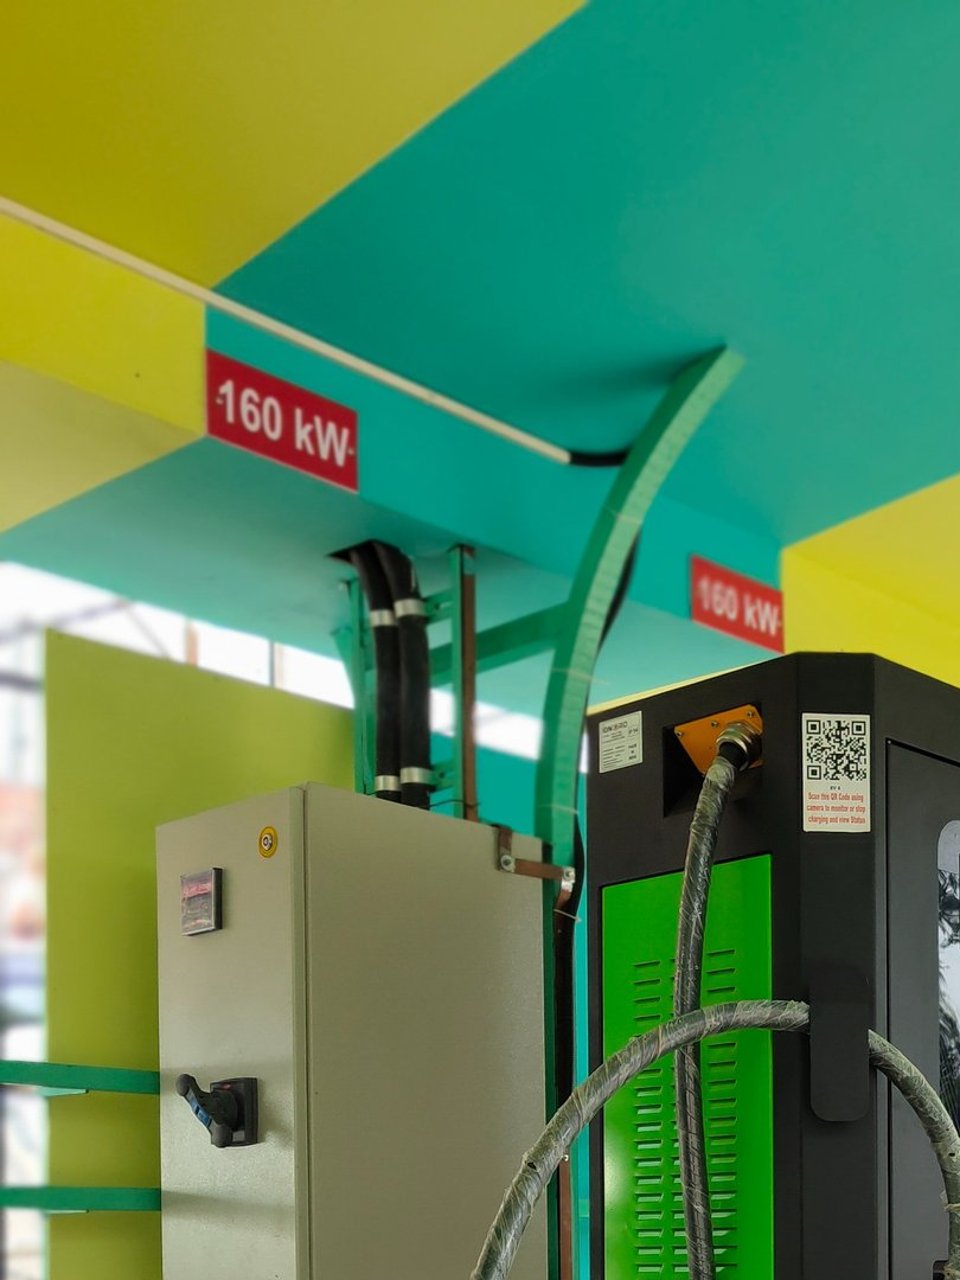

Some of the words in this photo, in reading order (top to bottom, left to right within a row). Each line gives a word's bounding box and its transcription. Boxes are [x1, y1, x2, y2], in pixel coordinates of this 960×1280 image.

[219, 379, 282, 441] 160
[295, 407, 349, 467] kW
[698, 576, 738, 621] 160
[744, 593, 779, 636] kW
[830, 793, 838, 801] QR
[839, 792, 850, 801] Code
